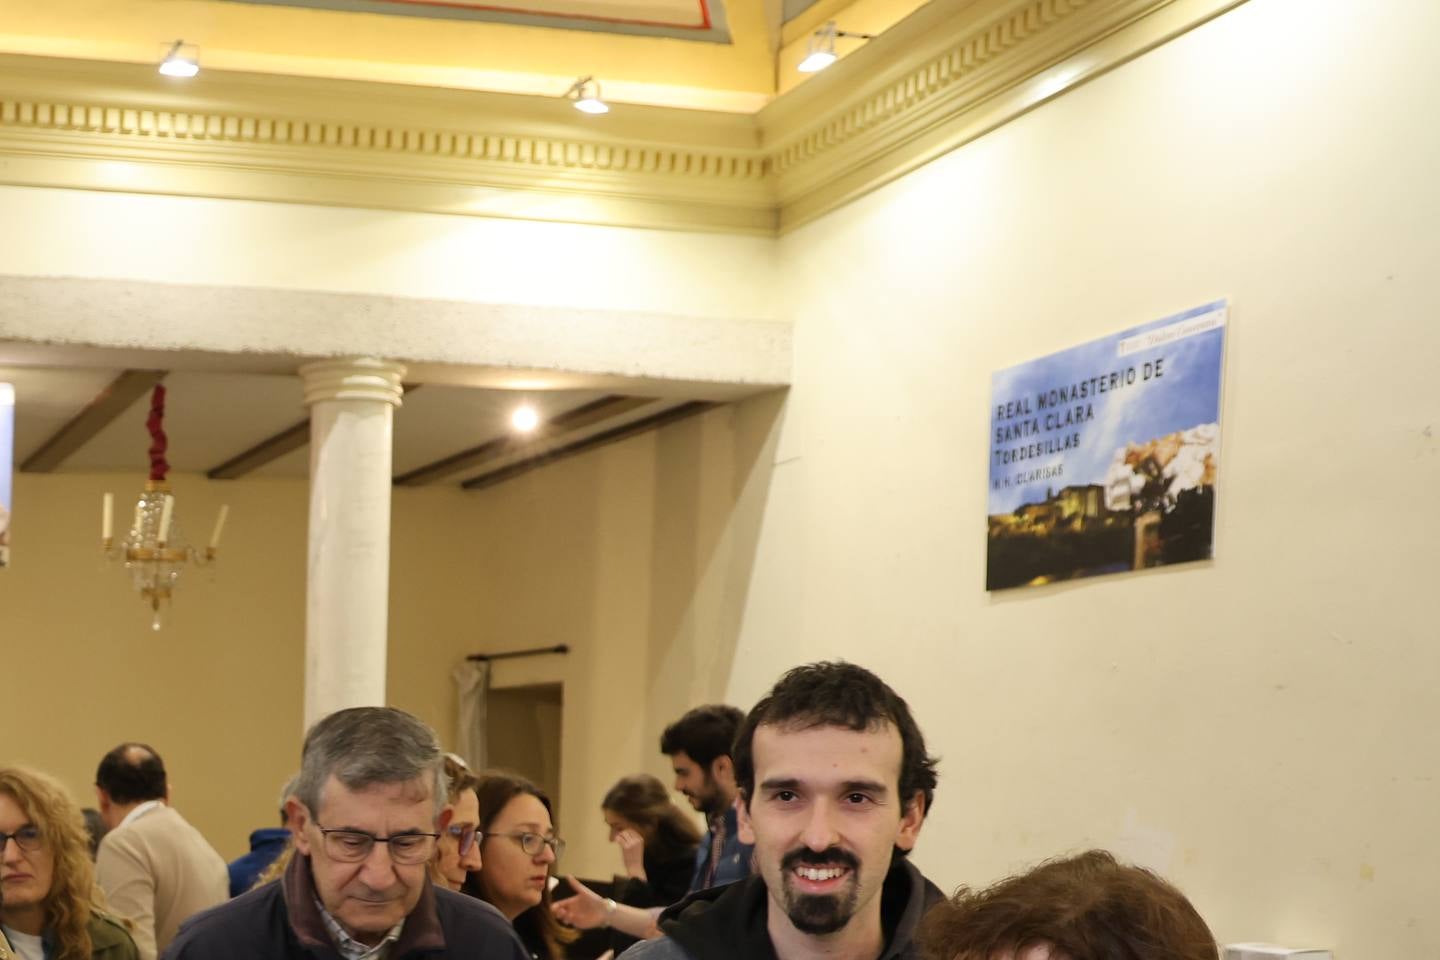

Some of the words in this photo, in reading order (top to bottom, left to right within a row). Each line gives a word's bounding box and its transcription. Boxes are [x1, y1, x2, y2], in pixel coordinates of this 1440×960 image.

[997, 398, 1032, 421] REAL
[1037, 367, 1137, 410] MONASTERIO
[1143, 358, 1165, 381] DE
[995, 420, 1040, 445] SANTA
[1045, 403, 1094, 432] CLARA
[994, 432, 1081, 467] TORDESILLAS
